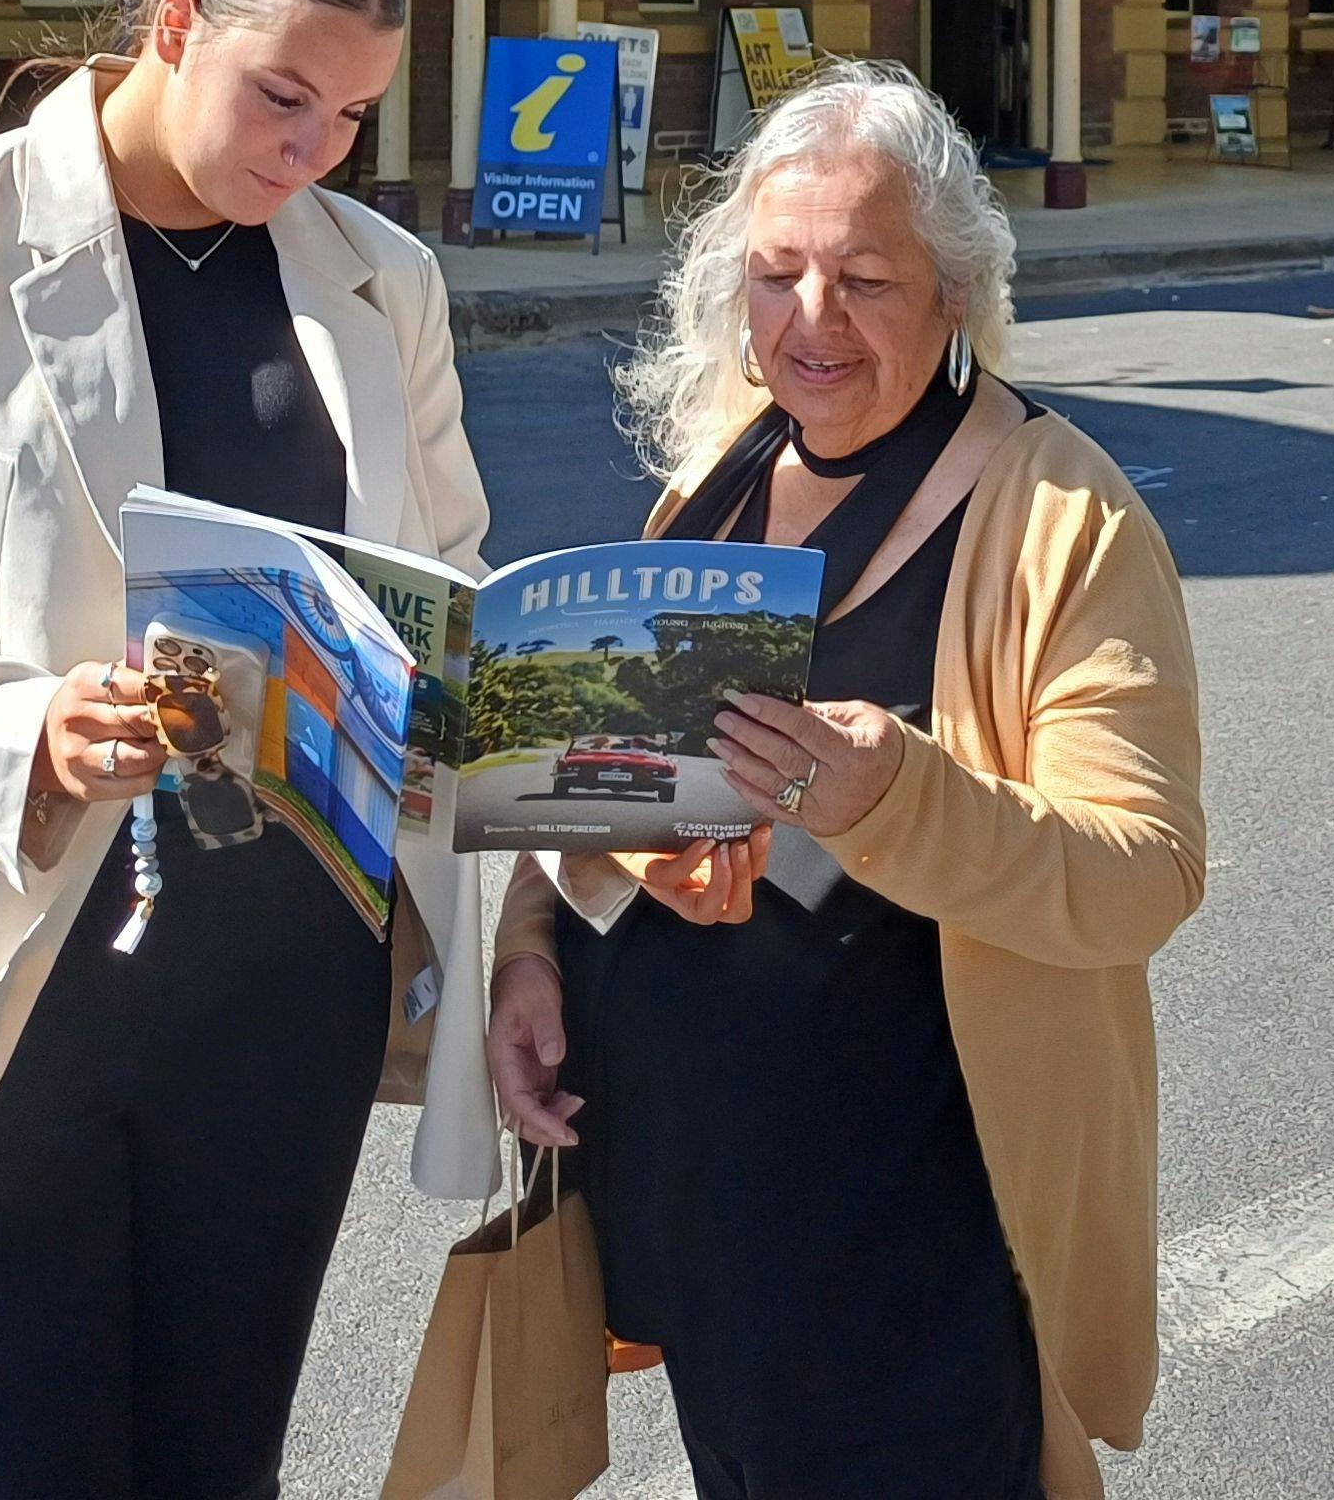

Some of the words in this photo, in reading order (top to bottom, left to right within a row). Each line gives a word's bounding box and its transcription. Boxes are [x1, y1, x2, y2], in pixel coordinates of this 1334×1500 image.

[745, 43, 772, 65] ART
[483, 171, 523, 186] Visitor
[525, 174, 596, 190] Information
[491, 190, 582, 221] OPEN
[520, 566, 764, 616] HILLTOPS
[652, 618, 689, 627] YOUNG
[687, 823, 752, 831] SOUTHERN
